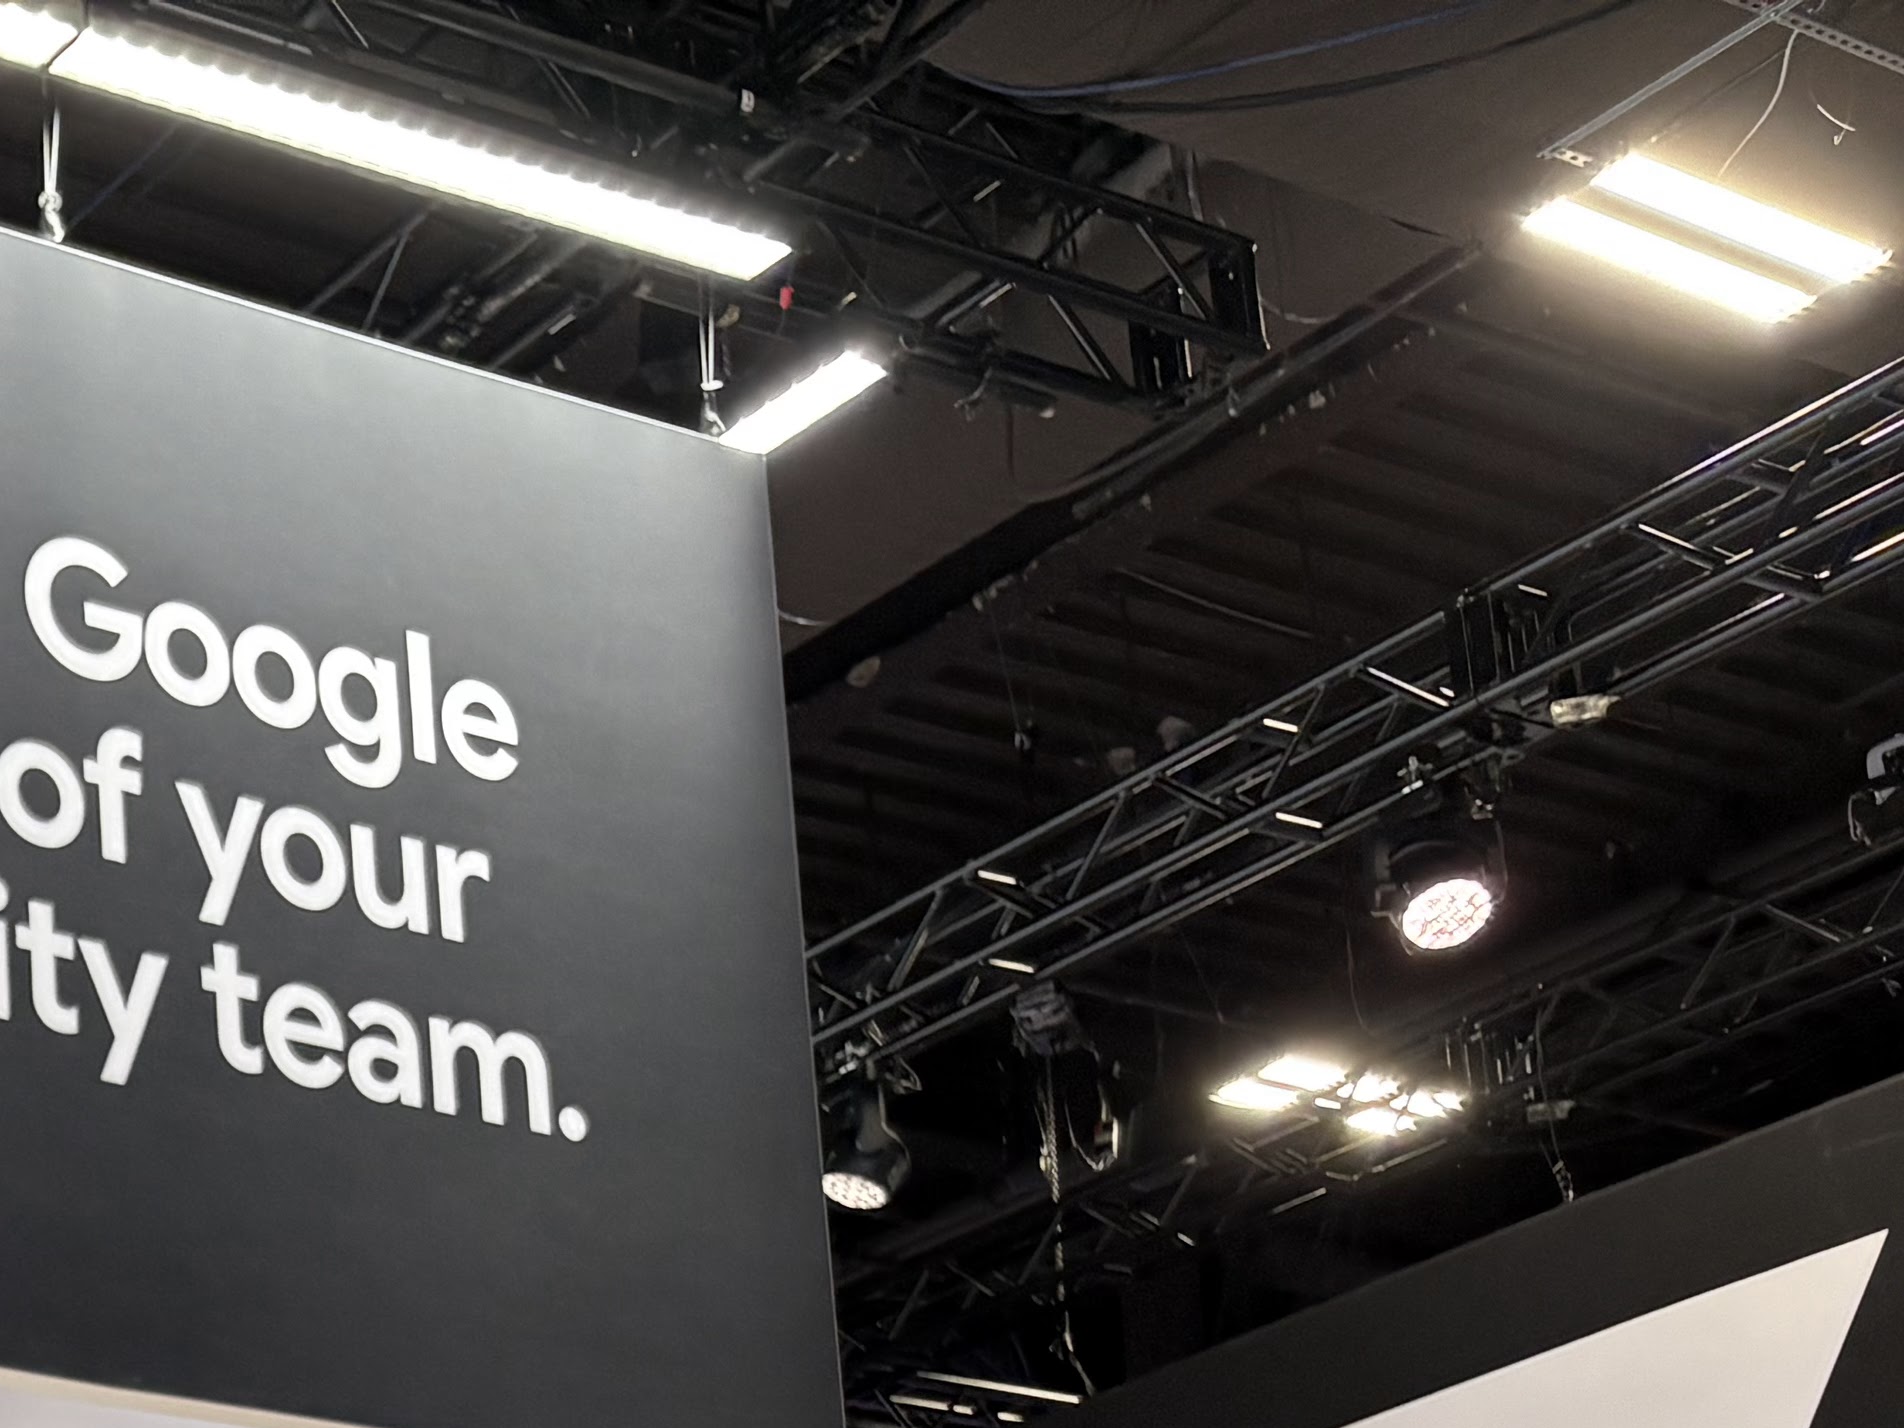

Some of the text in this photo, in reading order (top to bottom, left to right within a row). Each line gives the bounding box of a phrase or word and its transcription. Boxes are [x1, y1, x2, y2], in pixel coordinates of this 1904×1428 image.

[23, 536, 520, 789] Google
[176, 779, 490, 943] your
[200, 942, 588, 1142] team.
